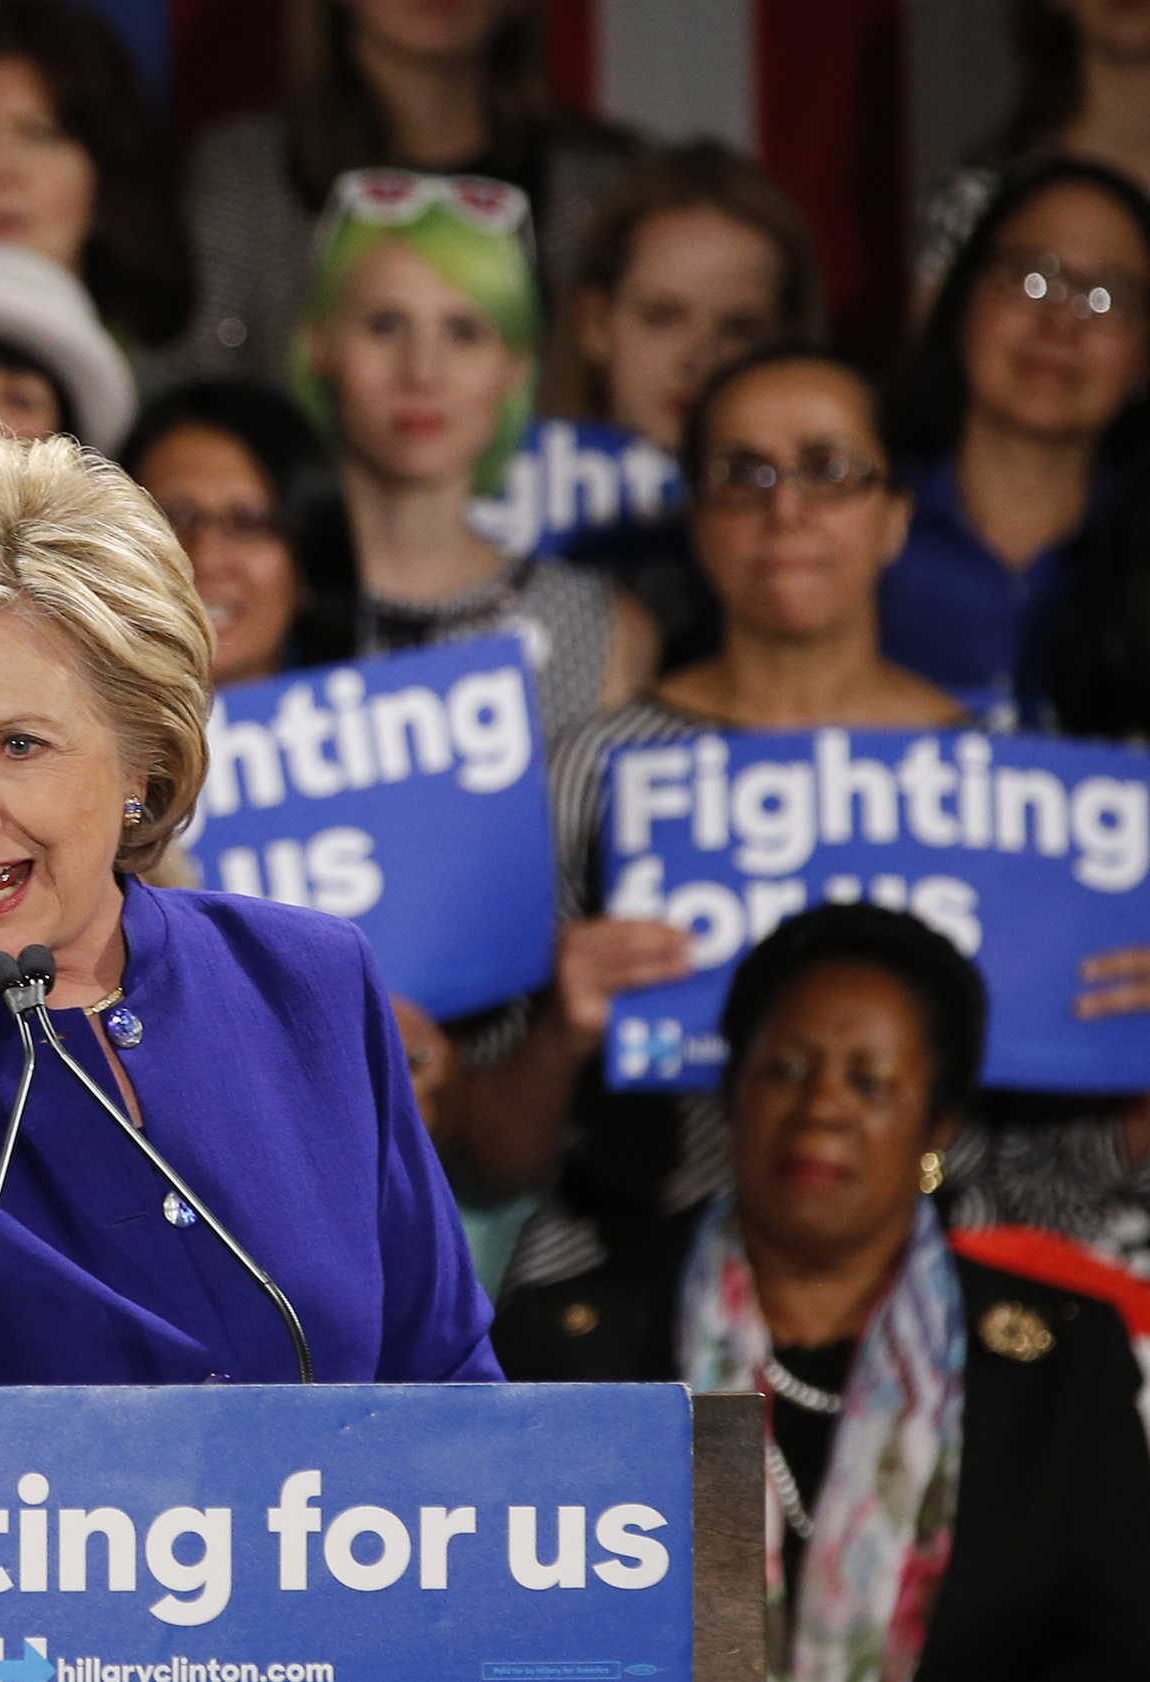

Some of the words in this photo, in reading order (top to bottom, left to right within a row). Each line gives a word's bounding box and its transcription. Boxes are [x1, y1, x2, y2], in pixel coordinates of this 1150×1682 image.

[180, 666, 533, 848] hting
[614, 727, 1150, 894] Fighting
[216, 826, 386, 919] us
[822, 873, 983, 959] s
[266, 1468, 478, 1592] for
[506, 1501, 672, 1592] us
[57, 1655, 335, 1682] hillaryclinton.com
